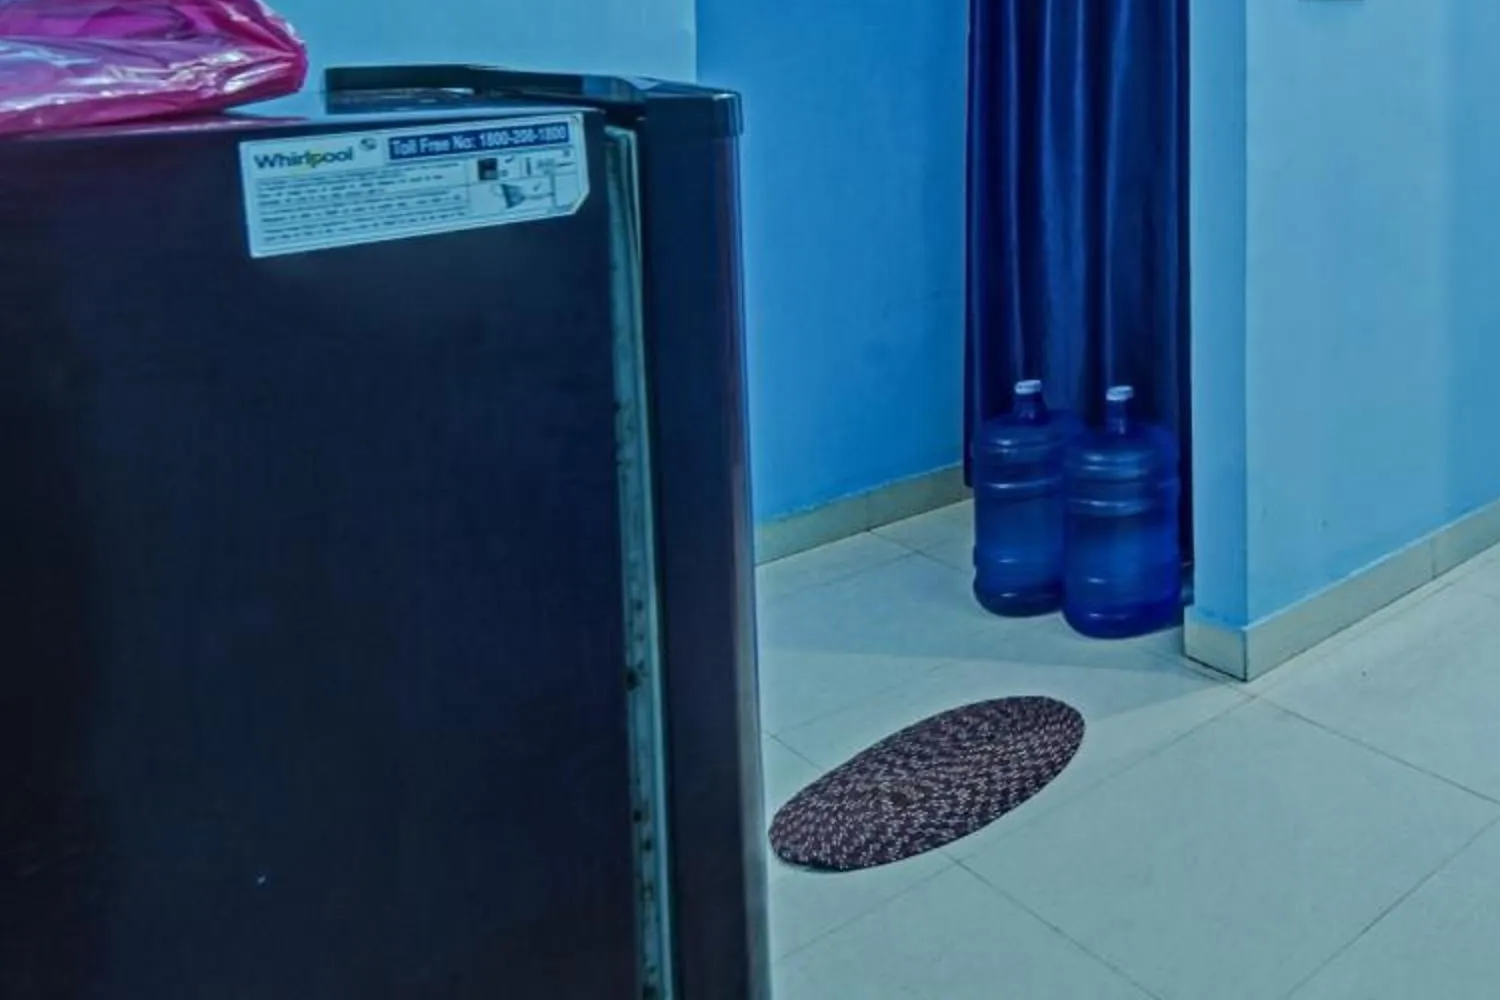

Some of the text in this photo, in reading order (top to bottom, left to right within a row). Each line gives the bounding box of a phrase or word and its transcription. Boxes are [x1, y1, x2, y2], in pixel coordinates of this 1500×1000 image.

[393, 138, 417, 155] Toll
[419, 136, 450, 152] Free
[254, 146, 353, 168] Whirlpool
